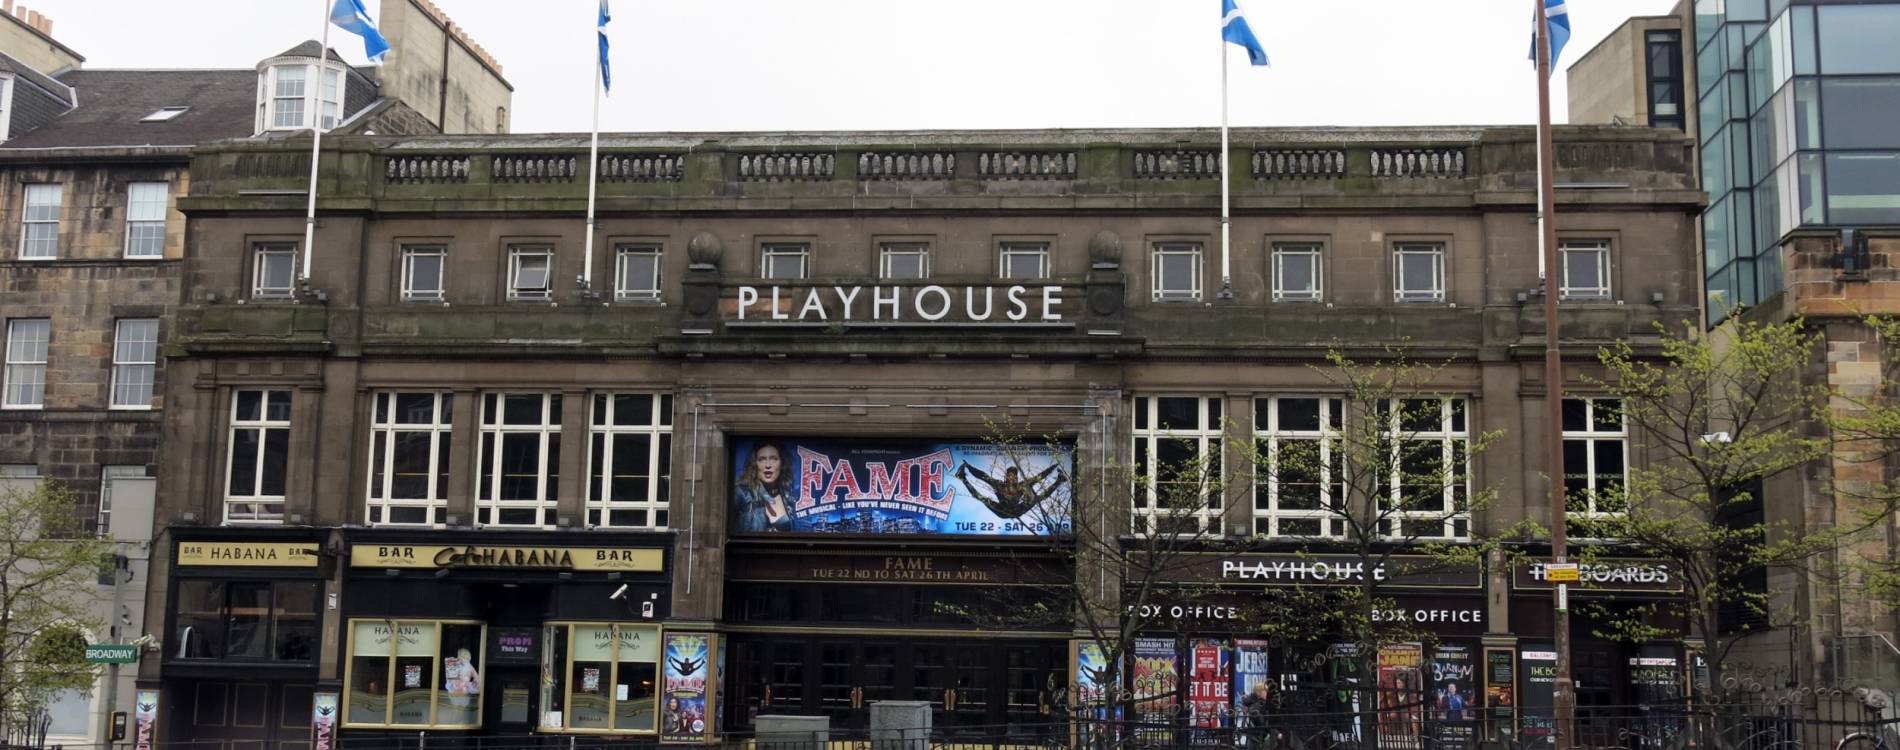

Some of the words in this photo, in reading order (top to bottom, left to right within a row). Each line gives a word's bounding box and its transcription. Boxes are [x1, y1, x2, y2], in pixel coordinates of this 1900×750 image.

[738, 285, 1063, 321] PLAYHOUSE
[795, 445, 956, 513] FAME
[809, 503, 837, 515] MUSICAL
[857, 501, 879, 509] YOU'VE
[880, 501, 900, 510] NEVER
[901, 503, 917, 512] SEEN
[918, 506, 925, 514] IT
[955, 522, 976, 531] TUE
[980, 522, 994, 531] 22
[1005, 522, 1025, 532] SAT
[1029, 522, 1043, 532] 26
[184, 546, 202, 554] BAR
[211, 547, 277, 560] HABANA
[379, 547, 414, 558] BAR
[483, 549, 573, 567] HABANA
[597, 550, 632, 562] BAR
[885, 557, 932, 570] FAME
[813, 569, 834, 578] TUE
[838, 569, 849, 578] 22
[855, 570, 870, 578] ND
[874, 570, 889, 579] TO
[895, 571, 914, 579] SAT
[919, 571, 933, 579] 26
[937, 571, 950, 579] TH
[956, 571, 988, 580] APRIL
[1579, 564, 1669, 583] BOARDS
[1170, 606, 1237, 619] OFFICE
[1371, 609, 1406, 621] BOX
[1414, 609, 1481, 622] OFFICE
[499, 637, 532, 646] PROM
[1135, 641, 1161, 649] SMASH
[85, 649, 133, 659] BROADWAY
[1214, 681, 1228, 697] BE
